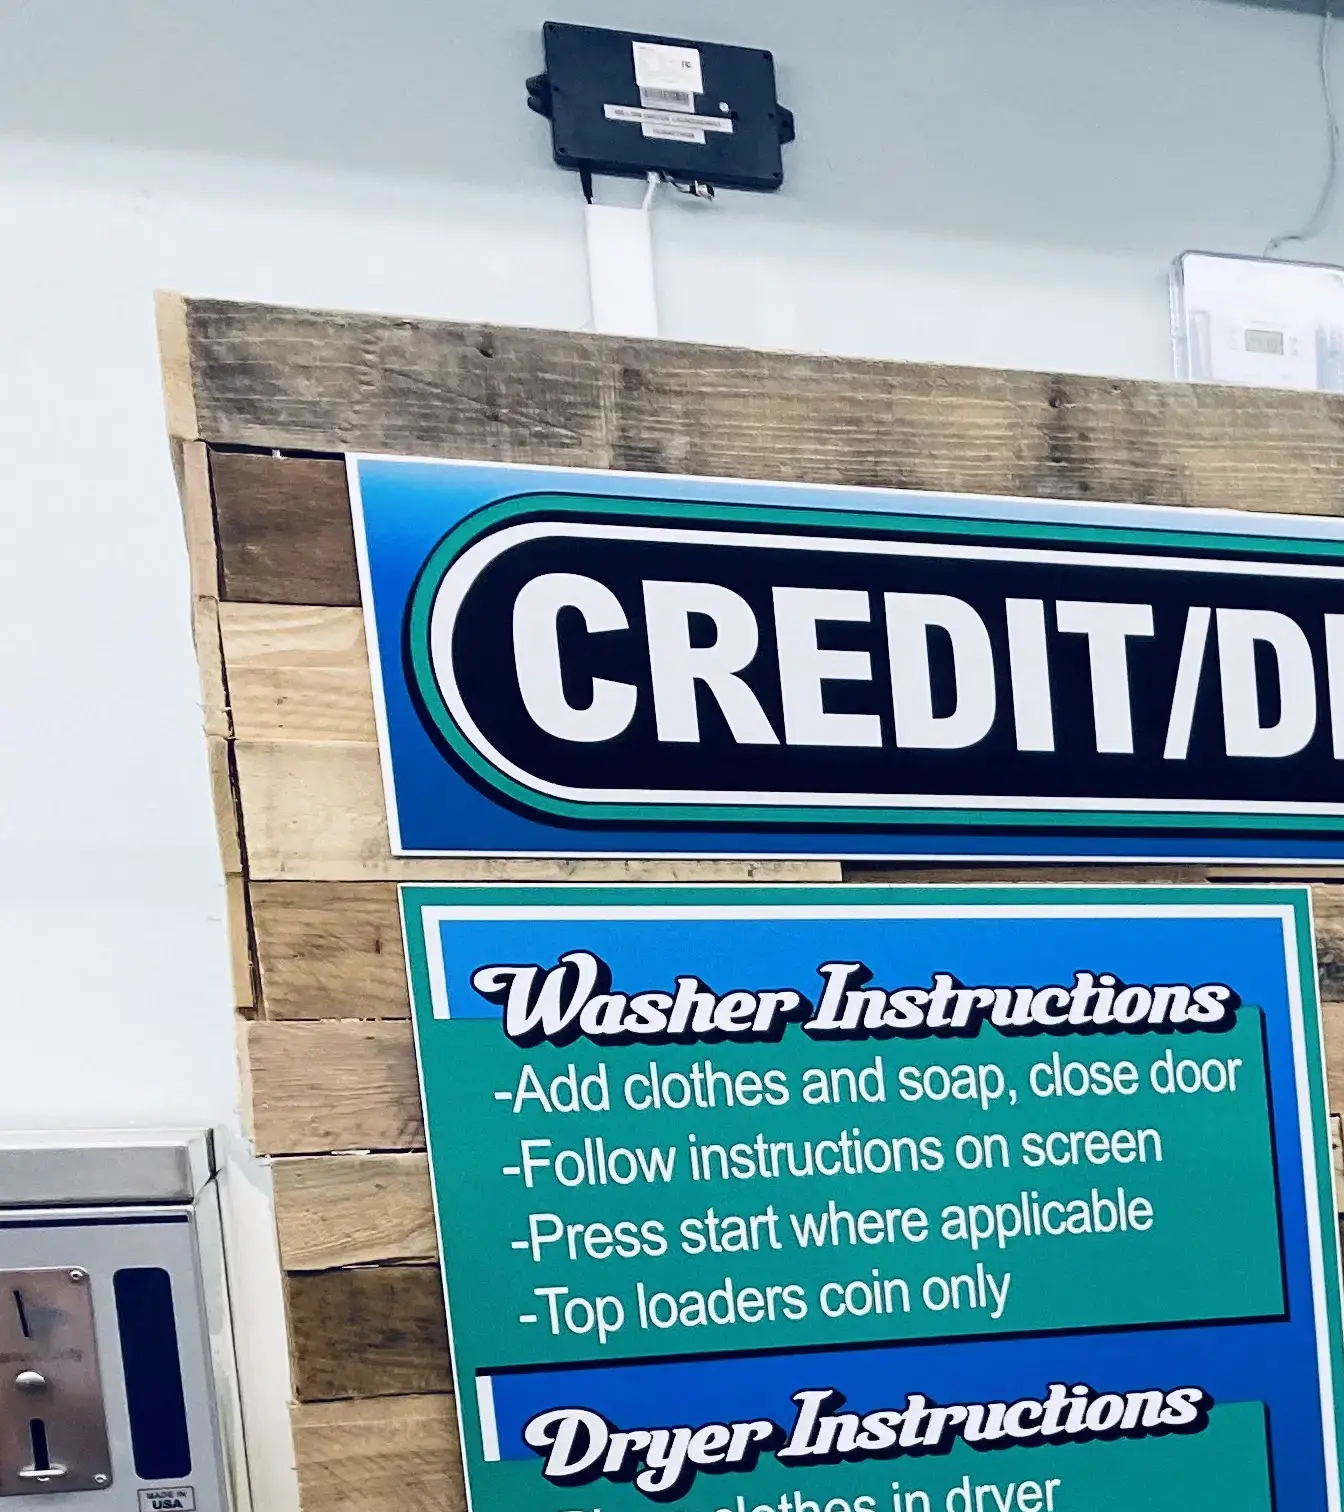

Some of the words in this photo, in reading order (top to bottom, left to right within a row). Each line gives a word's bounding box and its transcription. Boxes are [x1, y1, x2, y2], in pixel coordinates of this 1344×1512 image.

[474, 953, 799, 1036] Washer
[804, 964, 1229, 1029] Instructions
[495, 1063, 609, 1112] -Add
[625, 1061, 789, 1110] clothes
[803, 1056, 885, 1104] and
[899, 1065, 1016, 1110] soap,
[1030, 1052, 1138, 1096] close
[1151, 1049, 1242, 1093] door
[503, 1138, 676, 1187] -Follow
[689, 1128, 944, 1180] instructions
[956, 1135, 1009, 1169] on
[1022, 1129, 1162, 1166] screen
[512, 1214, 667, 1261] -Press
[681, 1205, 782, 1253] start
[790, 1201, 928, 1247] where
[942, 1188, 1152, 1250] applicable
[520, 1287, 624, 1343] -Top
[637, 1278, 807, 1328] loaders
[820, 1269, 910, 1317] coin
[923, 1263, 1010, 1318] only
[525, 1410, 772, 1491] Dryer
[778, 1385, 1202, 1456] Instructions
[152, 1499, 183, 1510] USA
